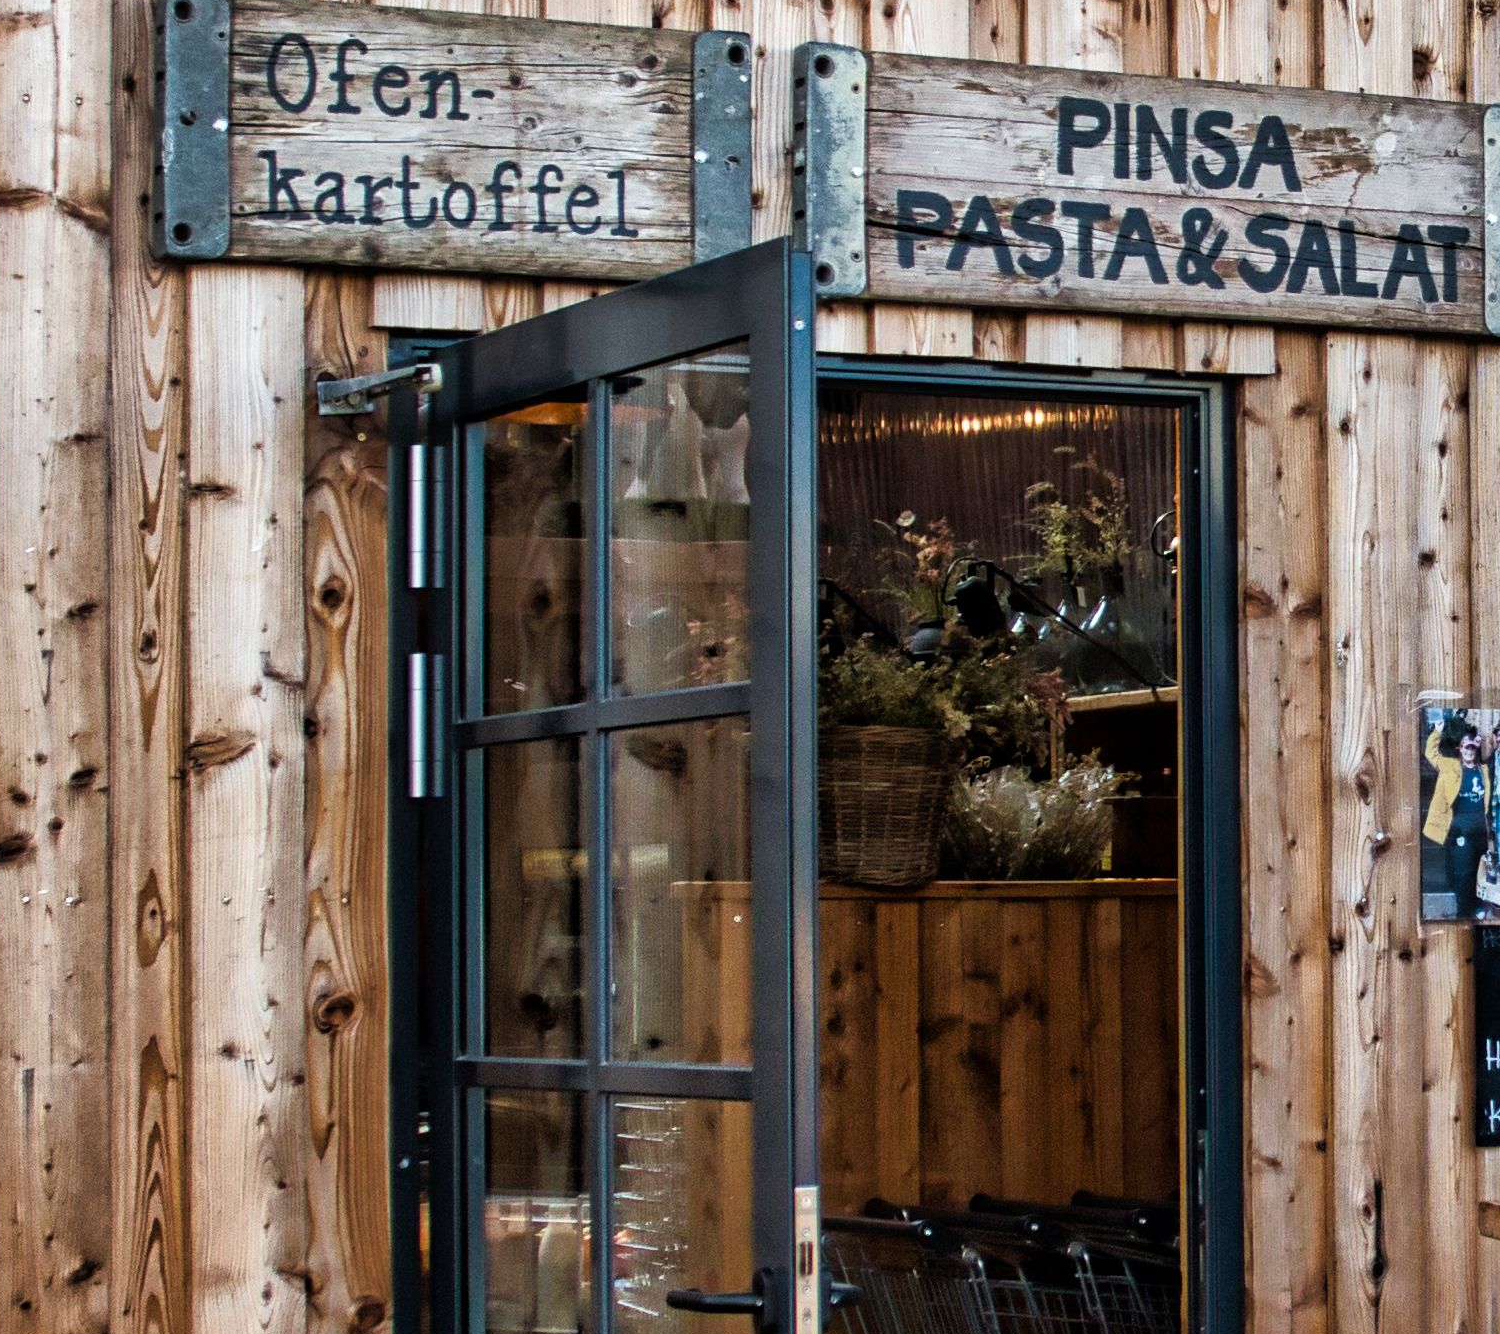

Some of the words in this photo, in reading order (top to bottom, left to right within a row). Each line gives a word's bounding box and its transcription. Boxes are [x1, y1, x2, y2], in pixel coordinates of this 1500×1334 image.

[267, 33, 495, 121] Ofen-
[1057, 95, 1301, 192] PINSA
[257, 149, 639, 238] kartoffel
